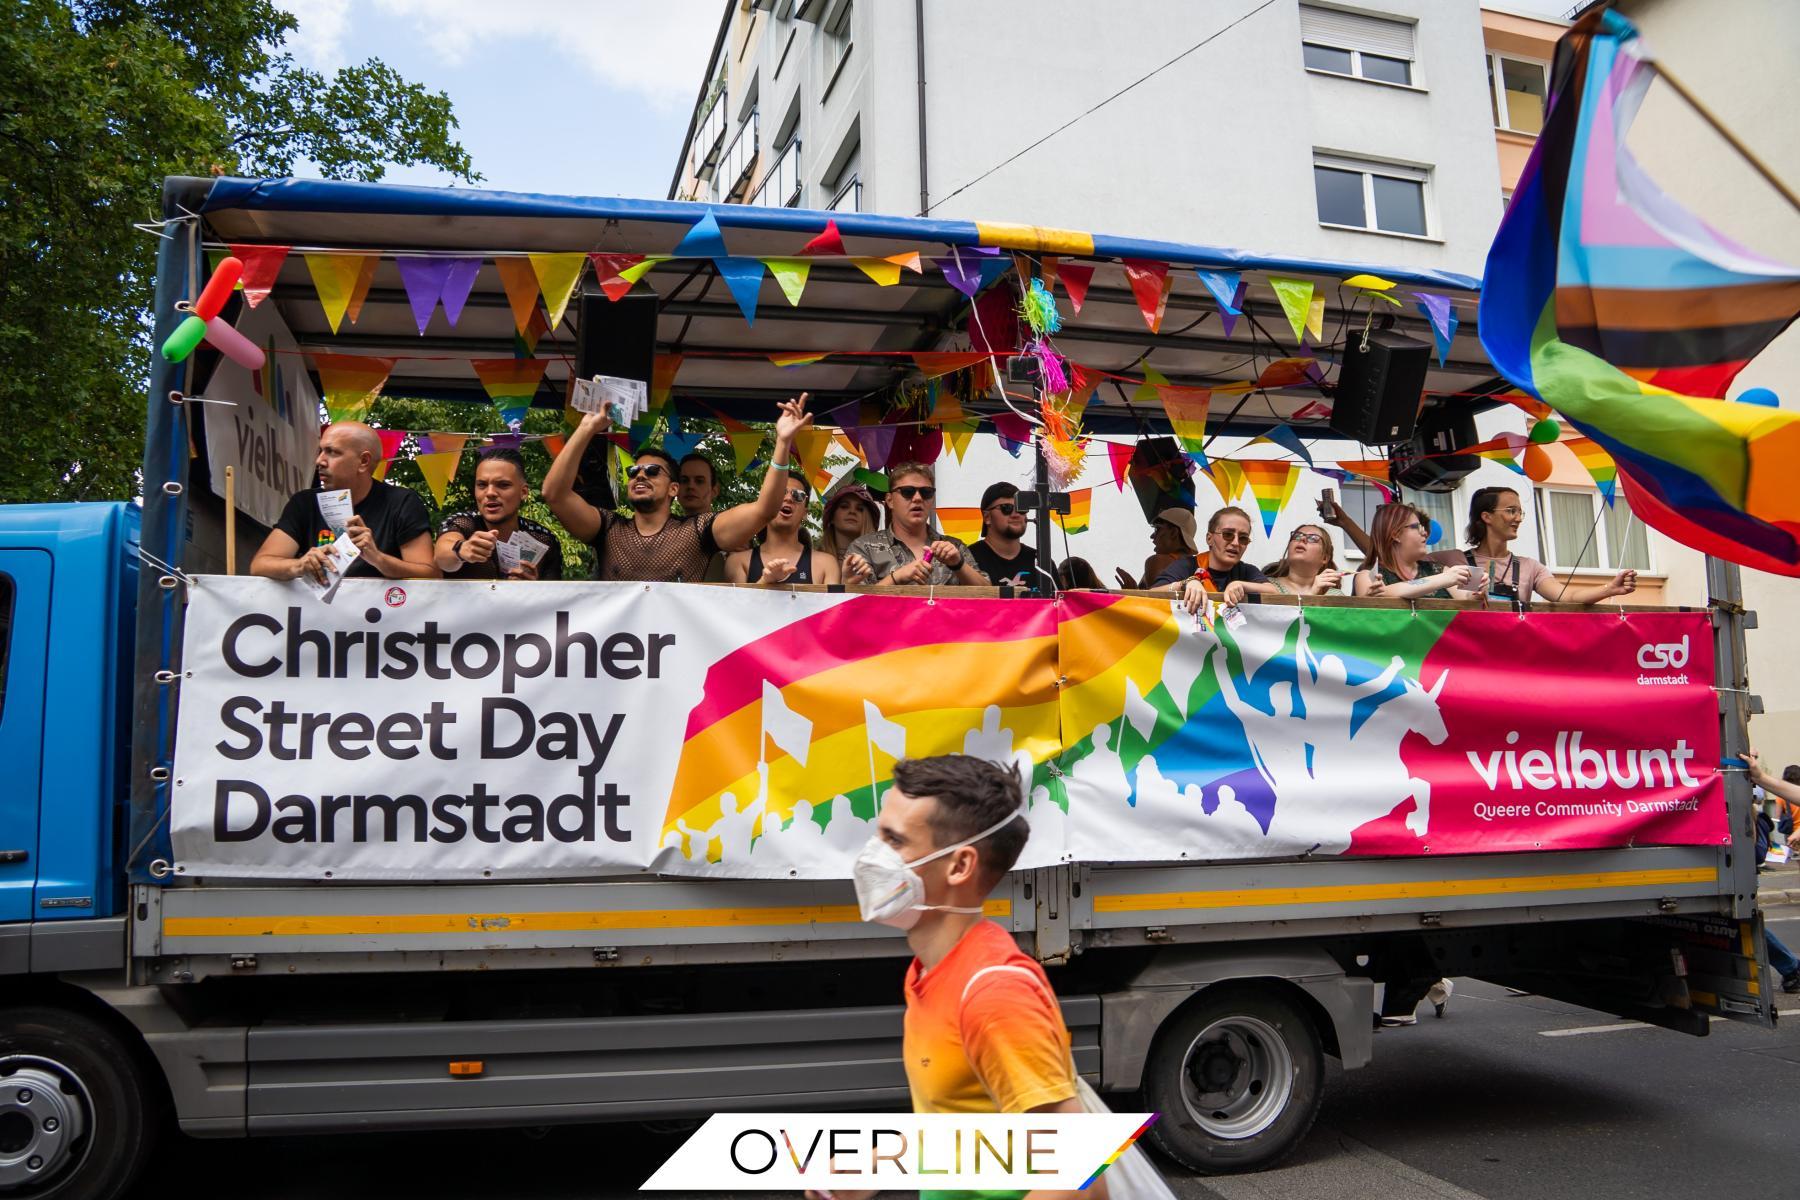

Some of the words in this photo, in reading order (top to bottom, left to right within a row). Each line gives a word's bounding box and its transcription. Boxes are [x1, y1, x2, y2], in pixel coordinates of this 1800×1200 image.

[222, 607, 676, 694] Christopher
[1637, 634, 1689, 669] csd
[1637, 674, 1689, 685] darmstadt
[215, 695, 458, 761] Street
[480, 696, 627, 777] Day
[1466, 731, 1700, 790] vielbunt
[214, 775, 632, 843] Darmstadt
[1473, 801, 1531, 821] Queere
[1535, 799, 1622, 817] Community
[1627, 796, 1699, 814] Darmstadt
